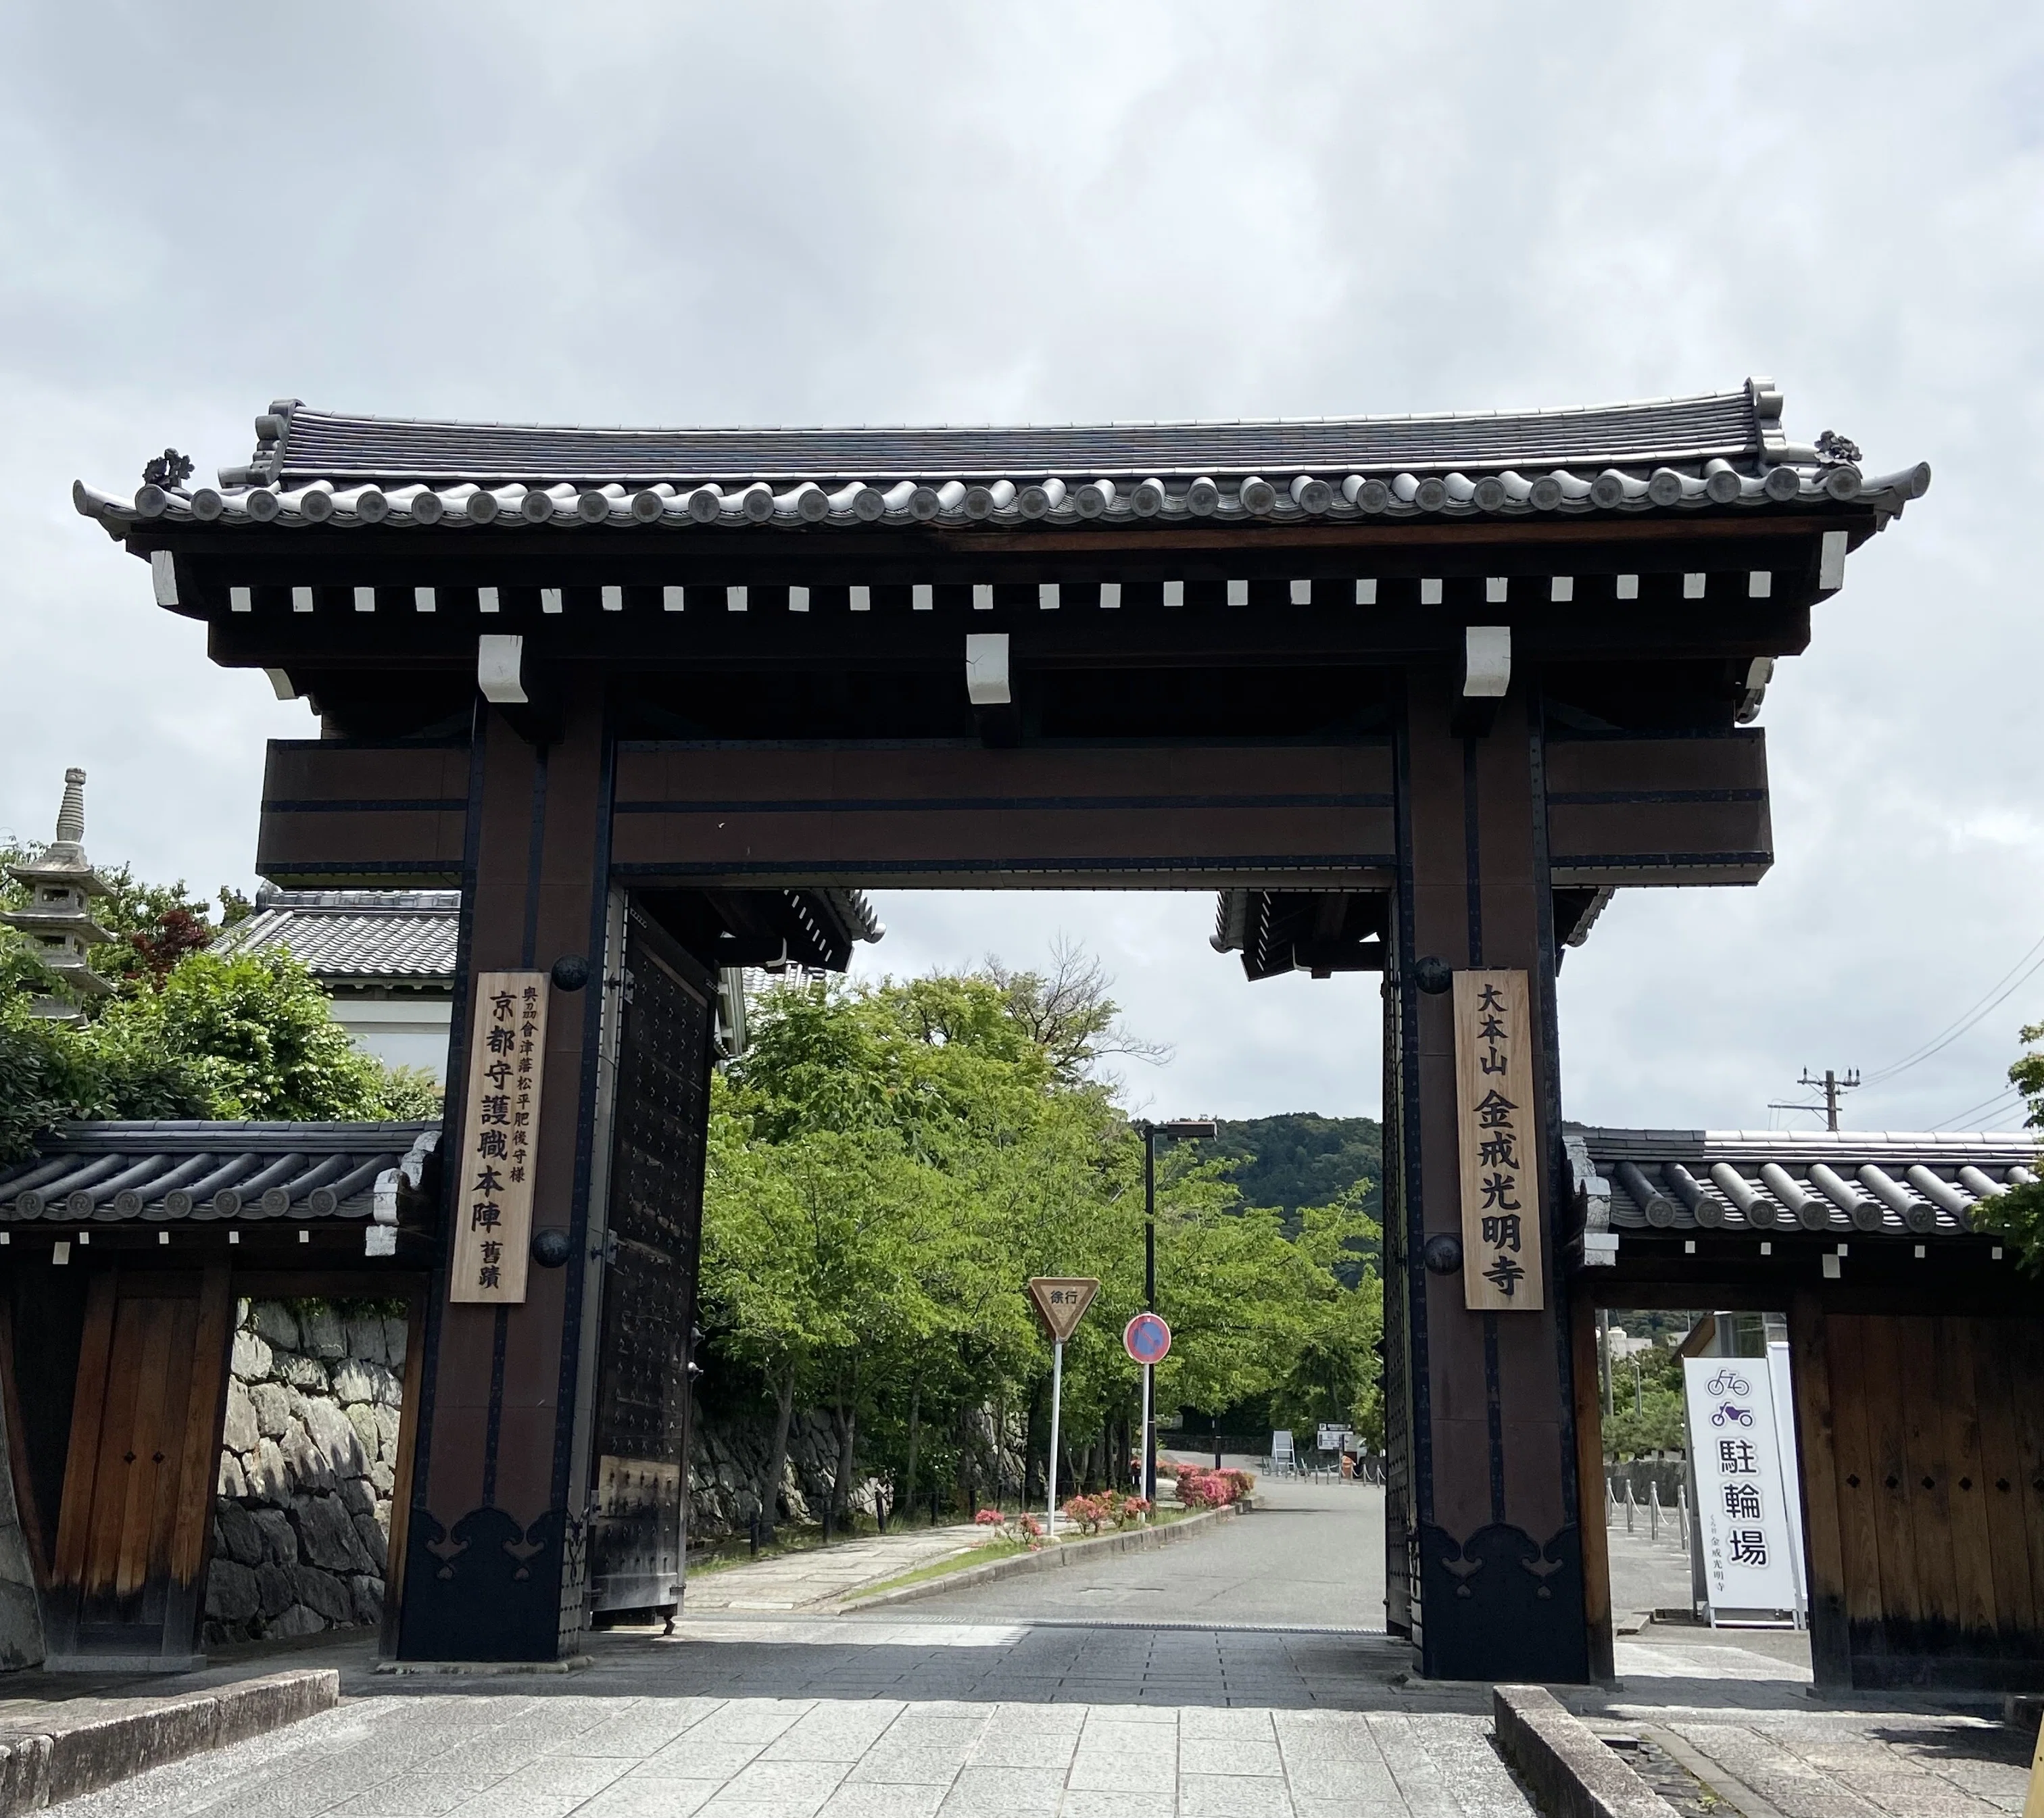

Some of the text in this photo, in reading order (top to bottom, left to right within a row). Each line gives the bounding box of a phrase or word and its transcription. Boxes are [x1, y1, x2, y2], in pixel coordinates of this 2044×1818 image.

[1050, 1290, 1078, 1304] 徐行
[1720, 1440, 1767, 1565] 駐輪場
